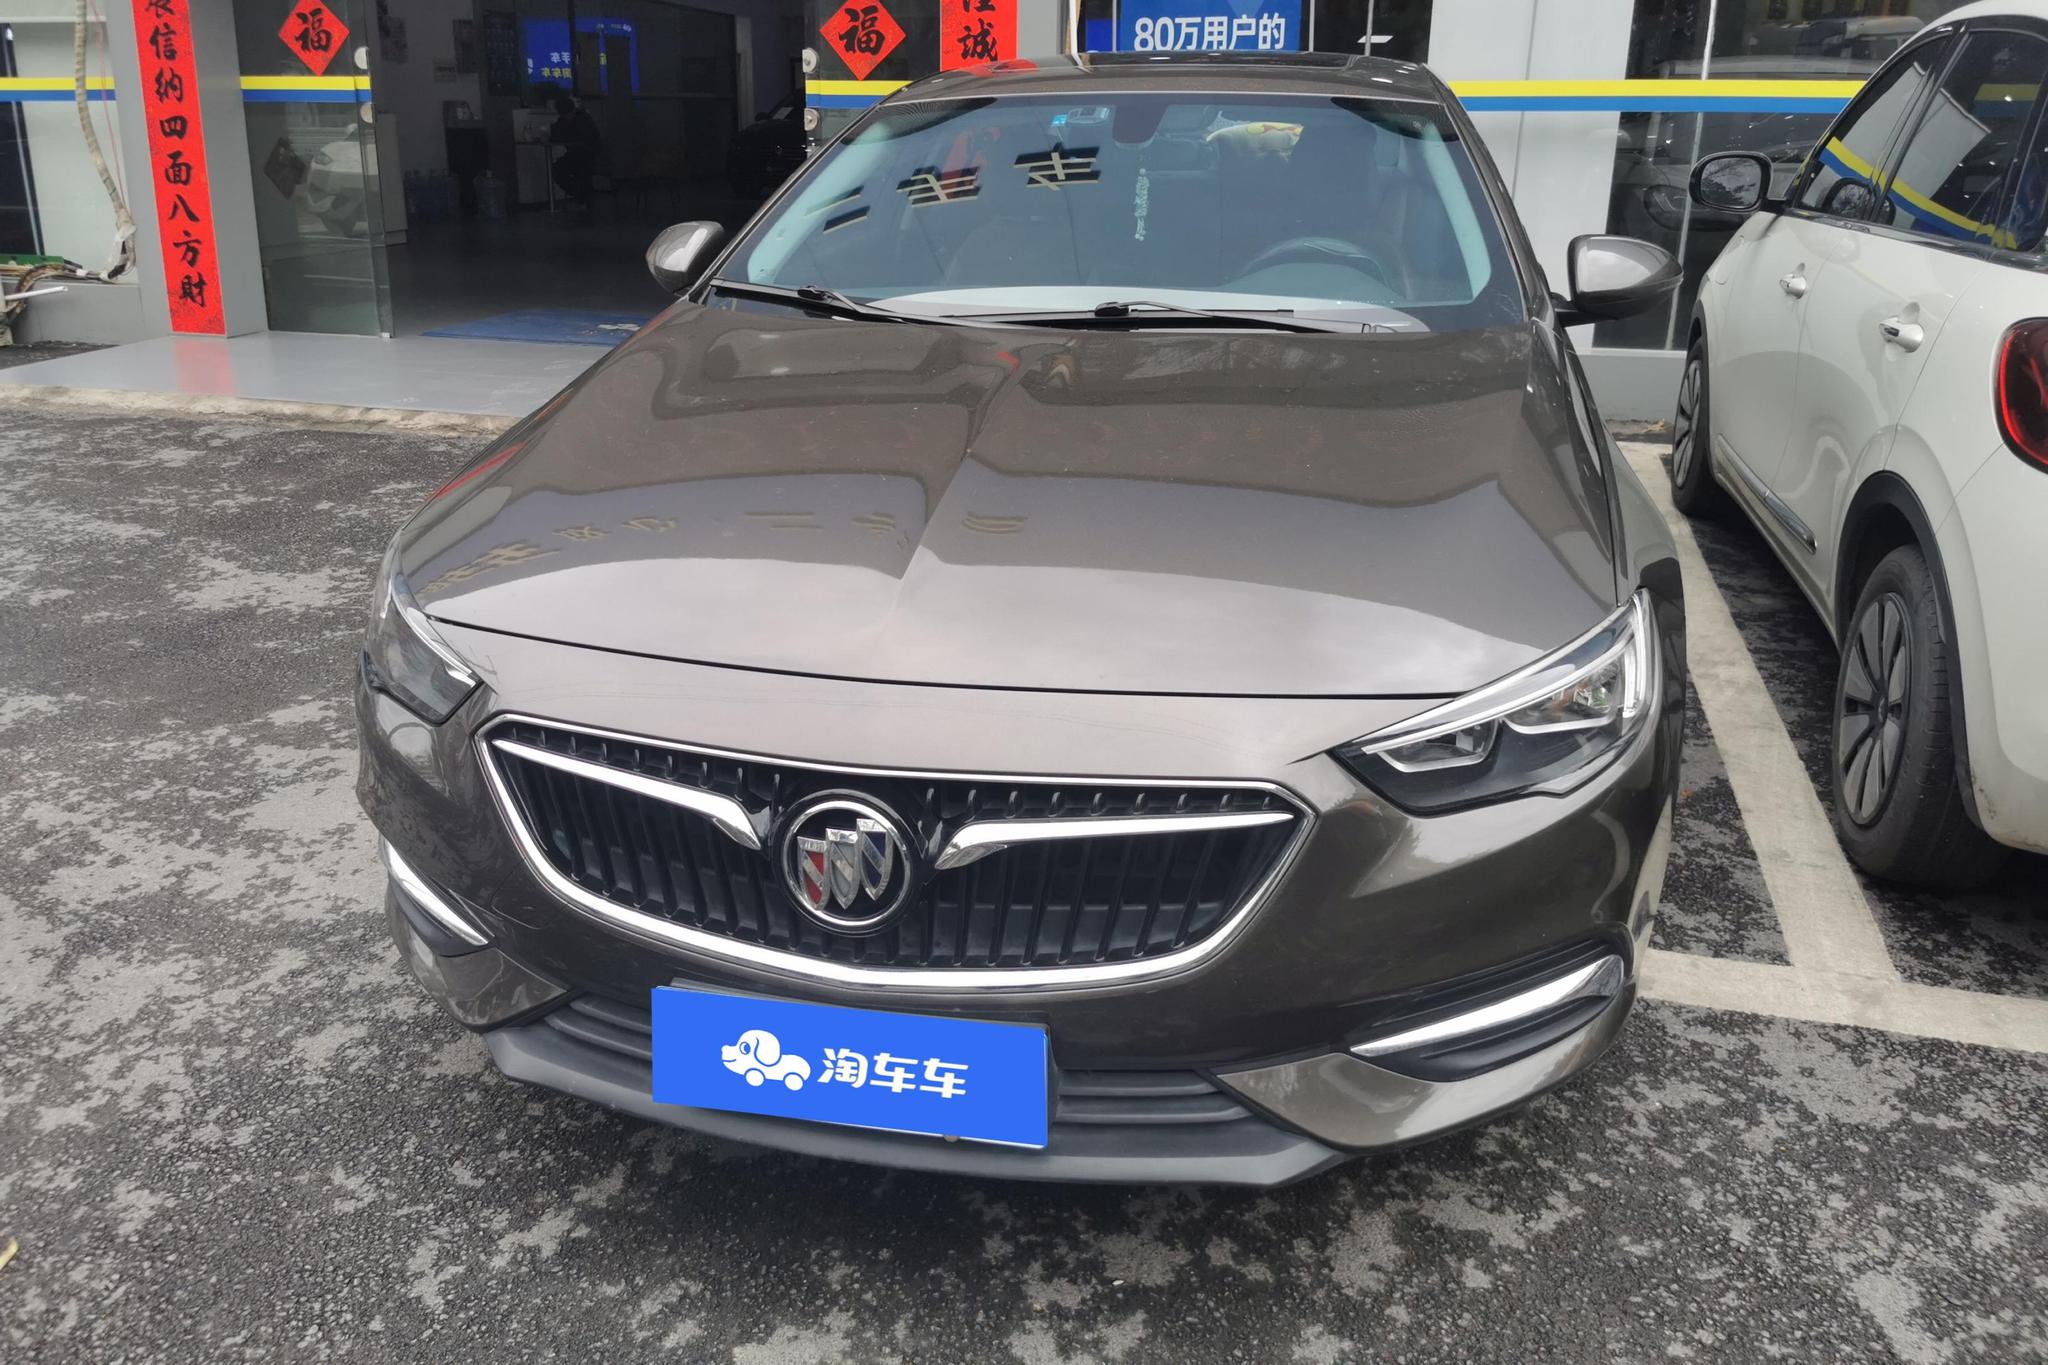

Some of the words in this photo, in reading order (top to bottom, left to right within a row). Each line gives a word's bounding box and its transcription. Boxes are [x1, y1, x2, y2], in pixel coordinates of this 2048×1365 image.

[294, 7, 332, 53] 福
[838, 5, 886, 56] 福
[1133, 12, 1286, 51] 80万用户的
